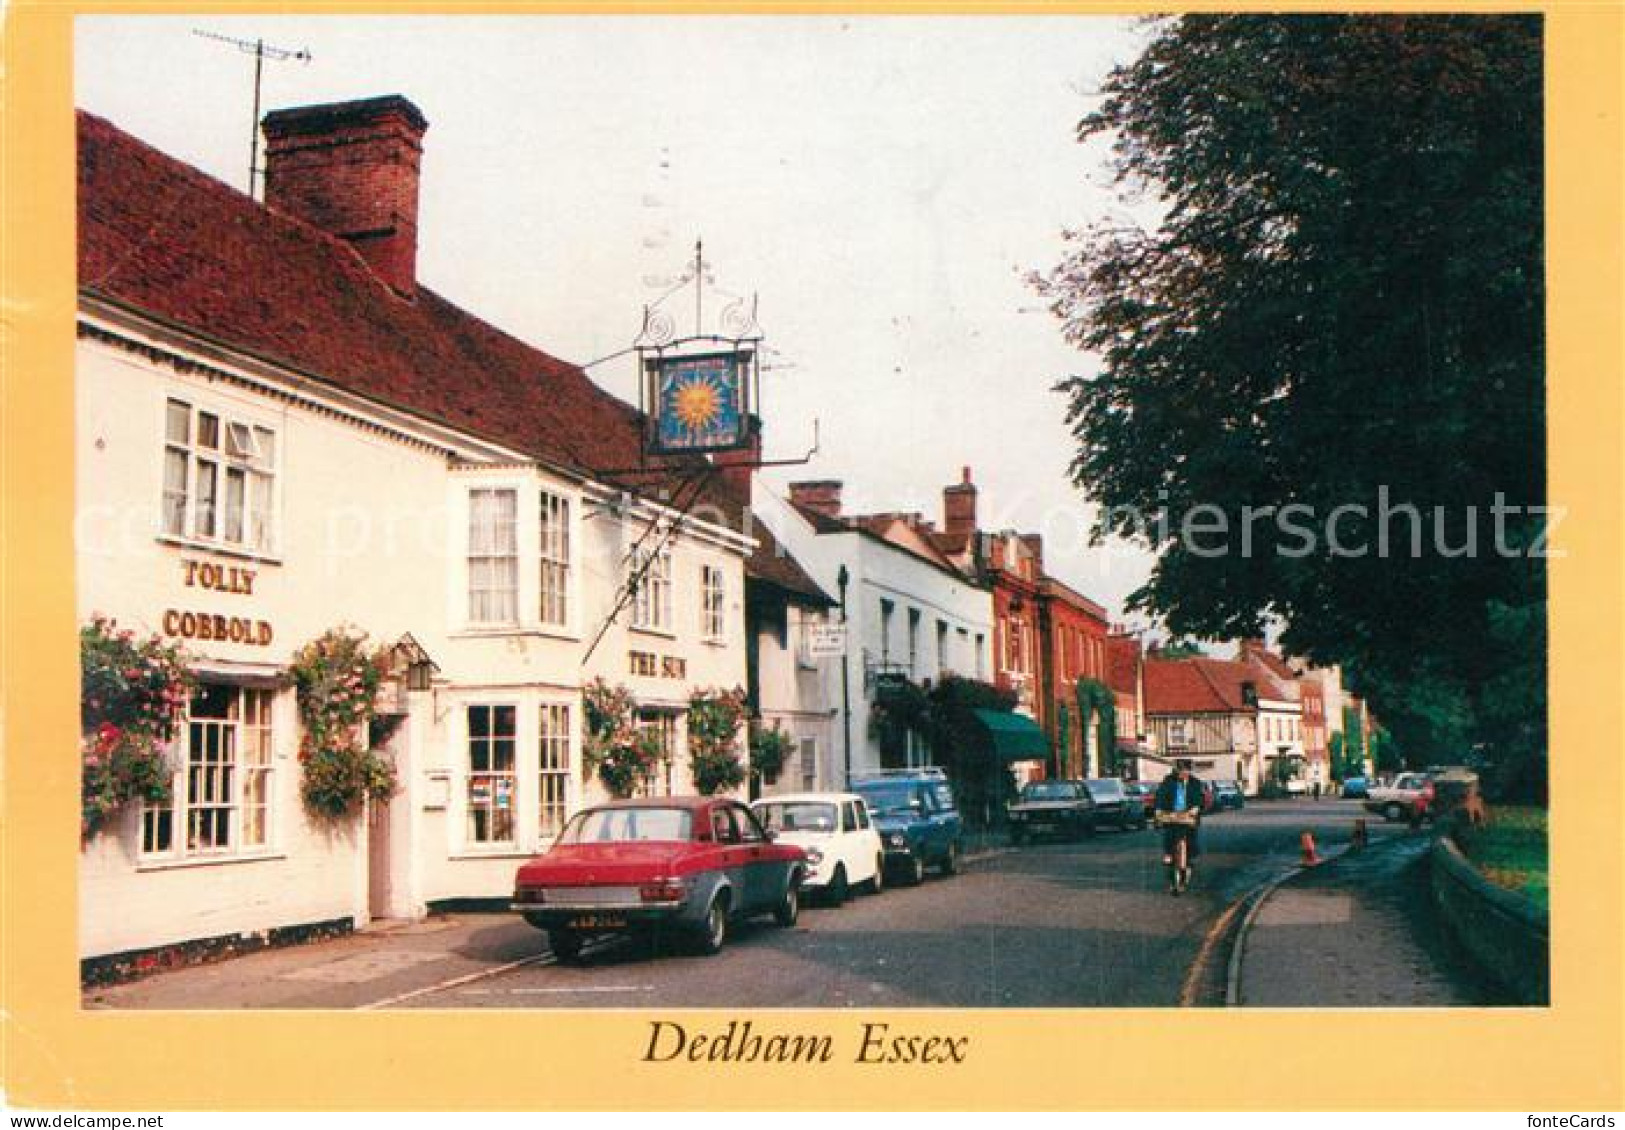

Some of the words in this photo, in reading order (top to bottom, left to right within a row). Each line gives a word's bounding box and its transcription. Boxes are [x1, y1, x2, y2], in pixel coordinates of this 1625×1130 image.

[182, 559, 257, 595] TOLLY
[162, 608, 273, 646] COBBOLD
[627, 649, 657, 678] THE
